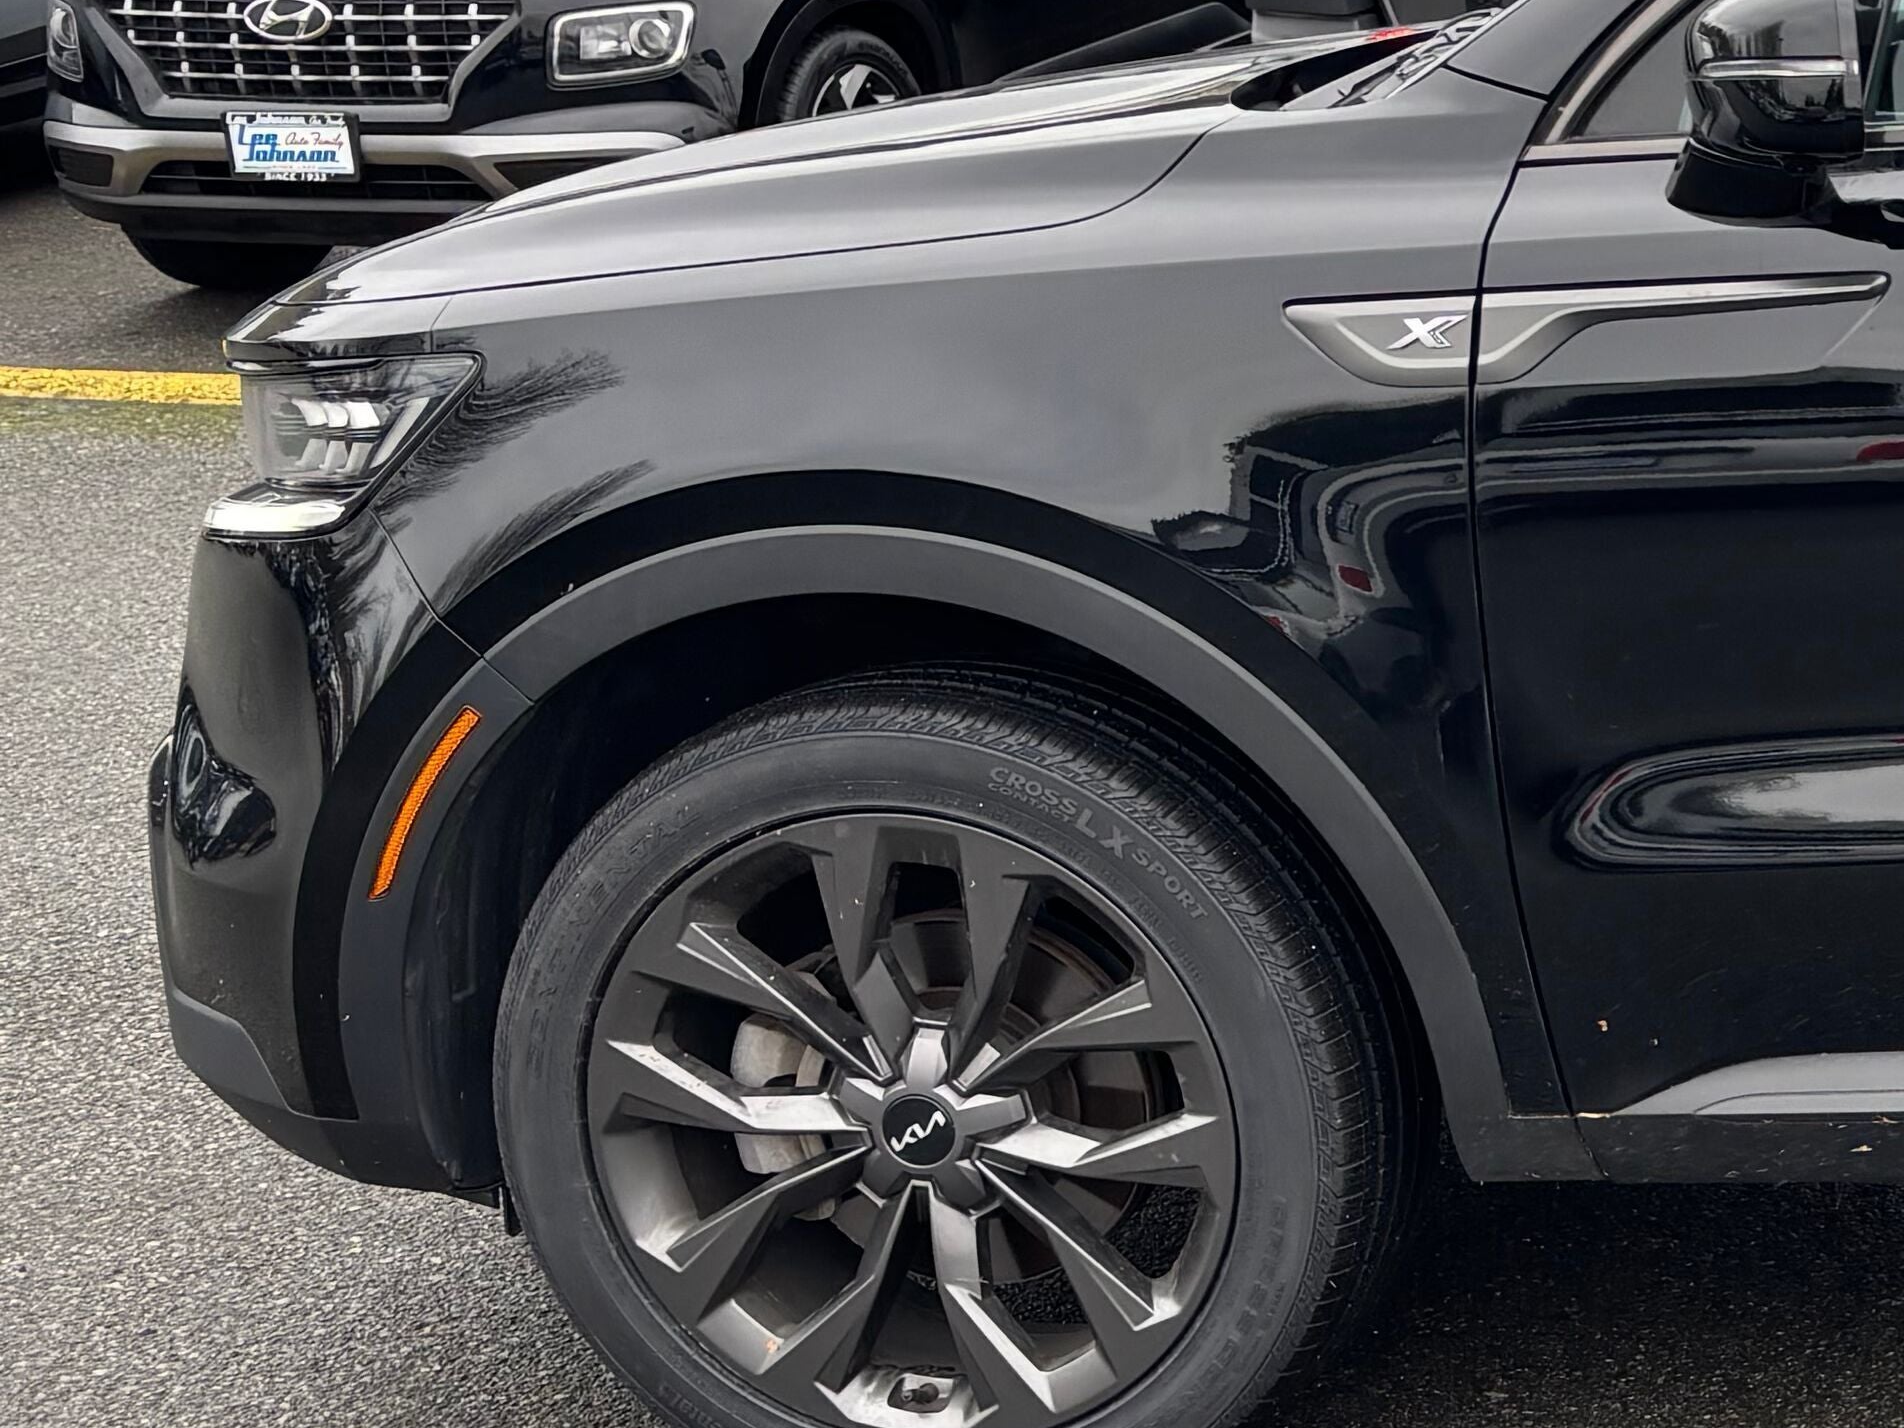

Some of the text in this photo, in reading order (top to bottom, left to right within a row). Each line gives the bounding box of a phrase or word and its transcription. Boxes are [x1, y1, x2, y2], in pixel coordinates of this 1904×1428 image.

[238, 125, 344, 150] Lee Auto Family
[242, 145, 340, 163] Johnson
[987, 782, 1072, 824] CONTACT
[989, 767, 1079, 816] CROSS
[1131, 847, 1209, 921] SPORT
